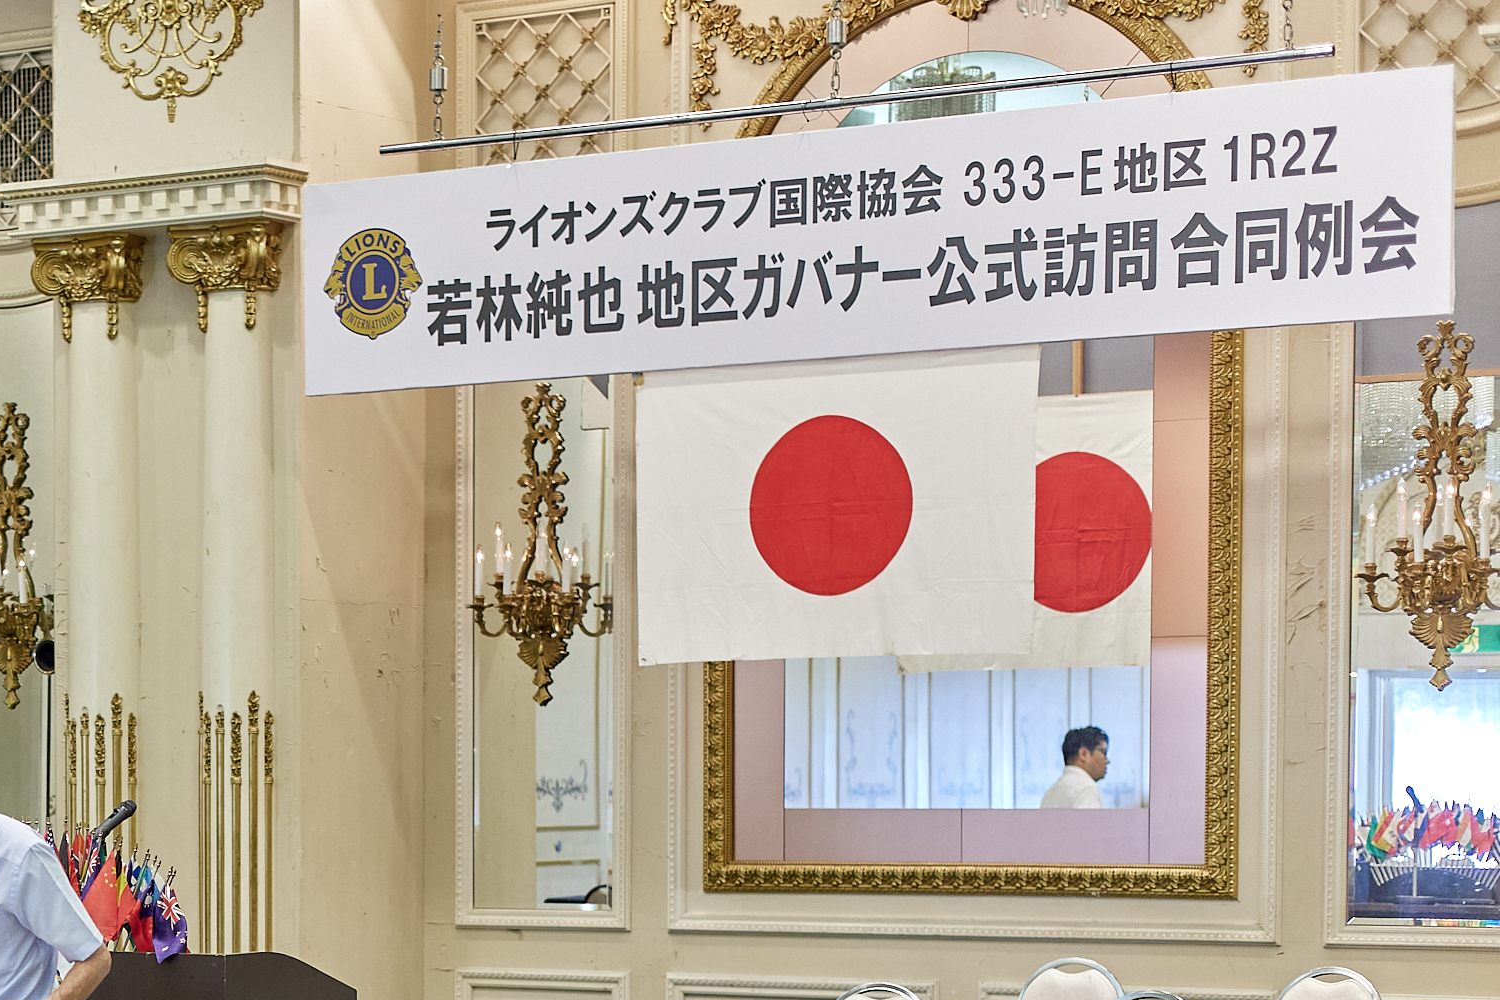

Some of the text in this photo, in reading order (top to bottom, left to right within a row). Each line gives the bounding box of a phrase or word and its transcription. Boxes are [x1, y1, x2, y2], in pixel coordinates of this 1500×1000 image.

[486, 164, 943, 251] ライオンズクラブ国際協会
[1223, 125, 1338, 182] 1R2Z
[344, 233, 401, 258] LIONS
[362, 263, 388, 301] L
[426, 195, 1420, 347] 若林純也 地区ガバナー公式訪問 合同例会
[345, 309, 401, 331] INTERNATIONAL
